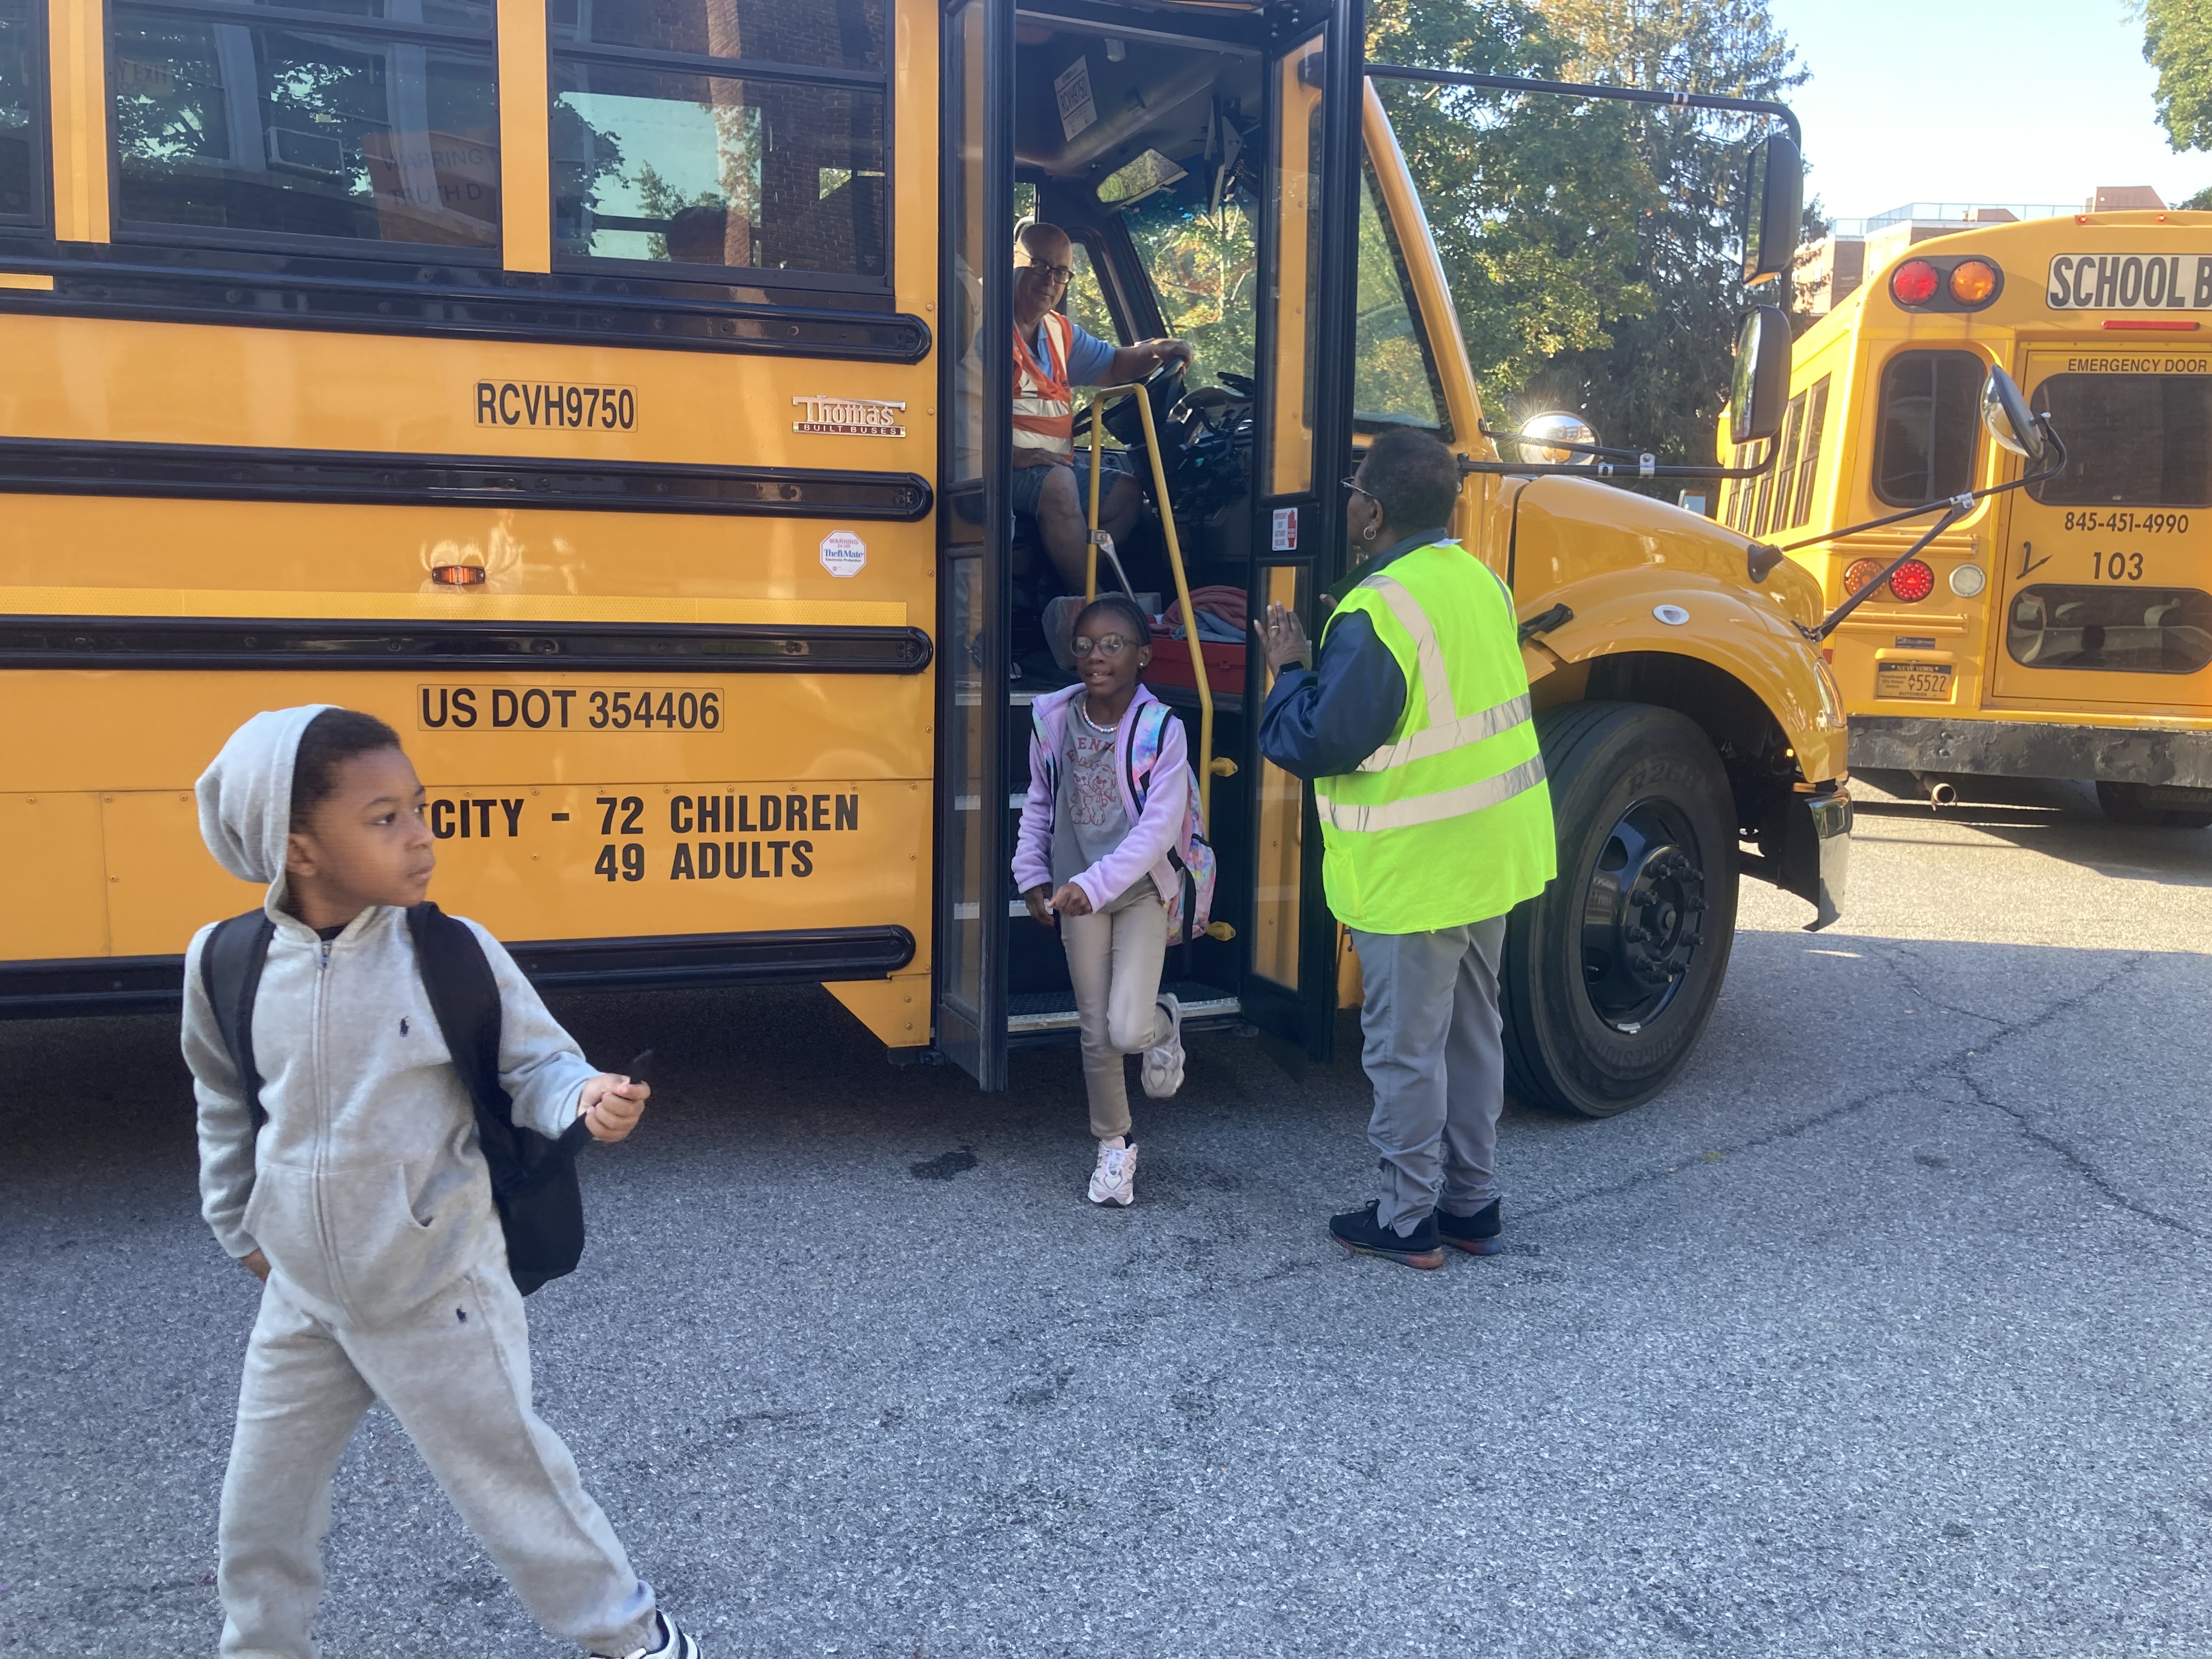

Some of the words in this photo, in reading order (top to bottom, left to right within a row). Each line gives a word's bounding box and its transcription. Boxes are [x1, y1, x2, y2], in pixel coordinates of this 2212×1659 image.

[2050, 256, 2185, 307] SCHOOL
[2193, 257, 2212, 307] B
[2068, 358, 2161, 372] EMERGENCY
[2164, 359, 2208, 373] DOOR
[477, 383, 634, 429] RCVH9750
[792, 395, 905, 426] Thomas
[804, 424, 843, 432] BUILT
[850, 426, 896, 435] BUSES
[2064, 512, 2188, 534] 845-451-4990
[2094, 552, 2143, 580] 103
[422, 688, 477, 728] US
[493, 689, 577, 729] DOT
[589, 691, 719, 729] 354406
[432, 799, 524, 839] CITY
[551, 812, 569, 821] -
[596, 797, 644, 836] 72
[670, 794, 859, 833] CHILDREN
[595, 843, 645, 882] 49
[670, 840, 814, 881] ADULTS
